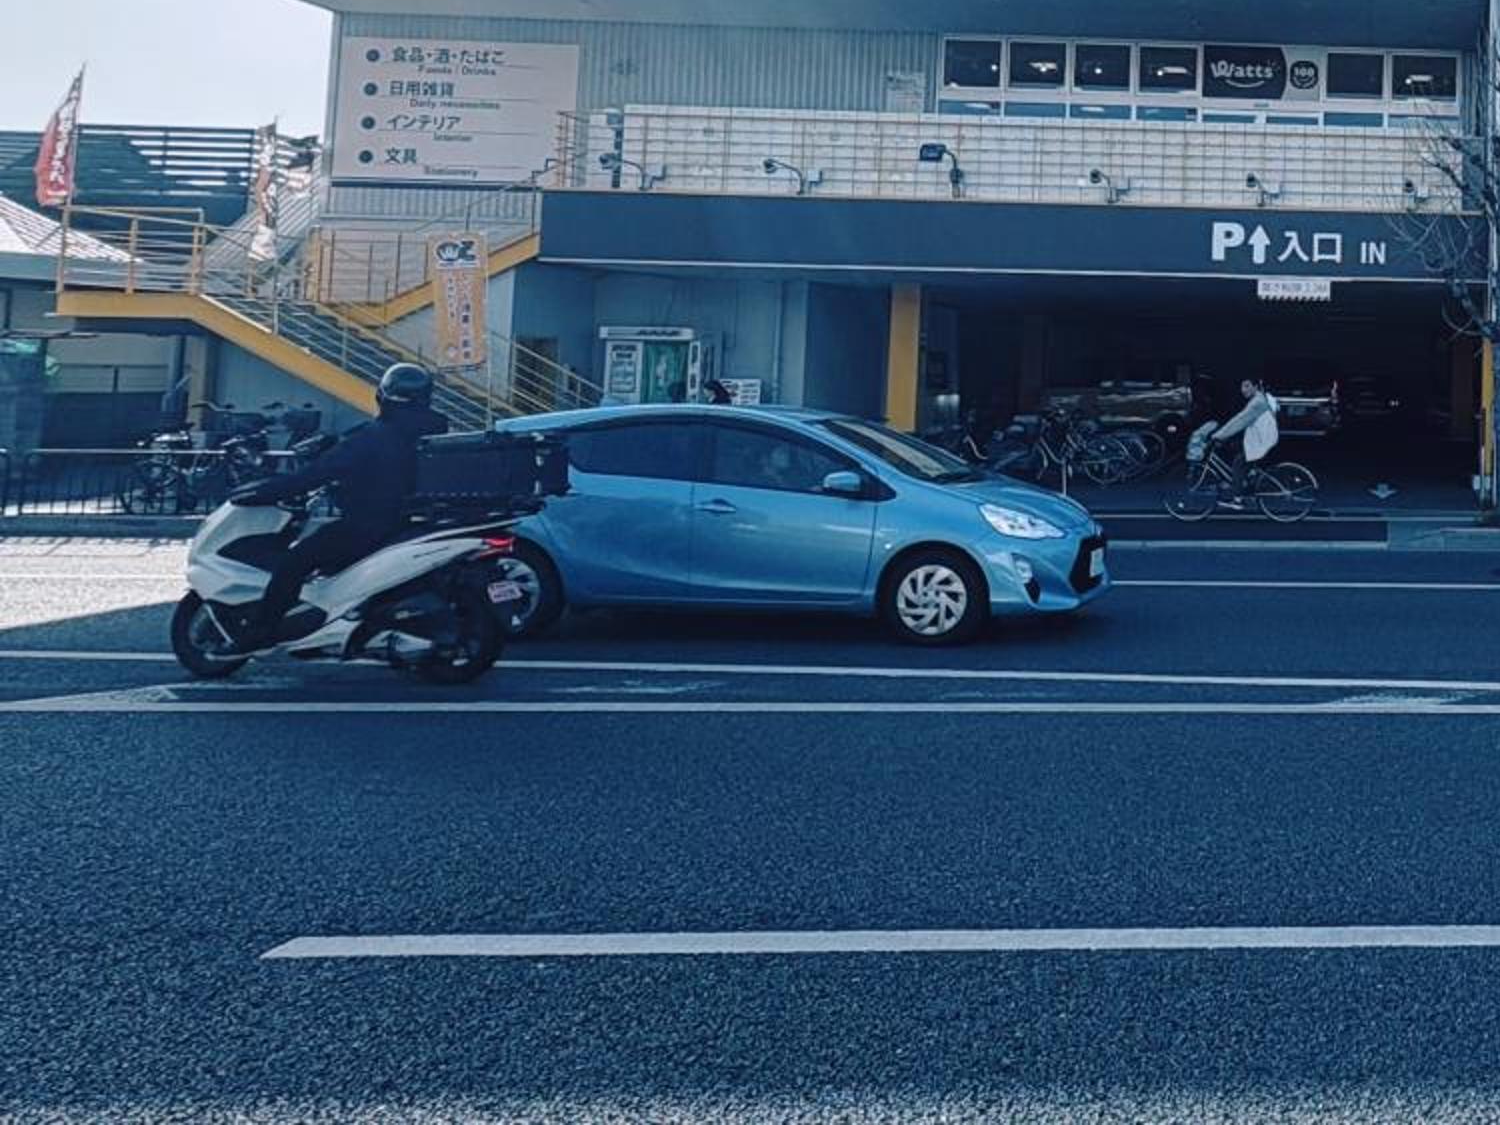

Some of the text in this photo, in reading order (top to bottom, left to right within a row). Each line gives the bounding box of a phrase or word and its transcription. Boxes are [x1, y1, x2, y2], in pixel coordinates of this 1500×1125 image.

[1210, 59, 1275, 79] Watts
[389, 81, 455, 97] 日用雑貨
[386, 114, 461, 131] インテリア
[383, 147, 418, 165] 文具
[1211, 221, 1387, 265] P 入口 IN
